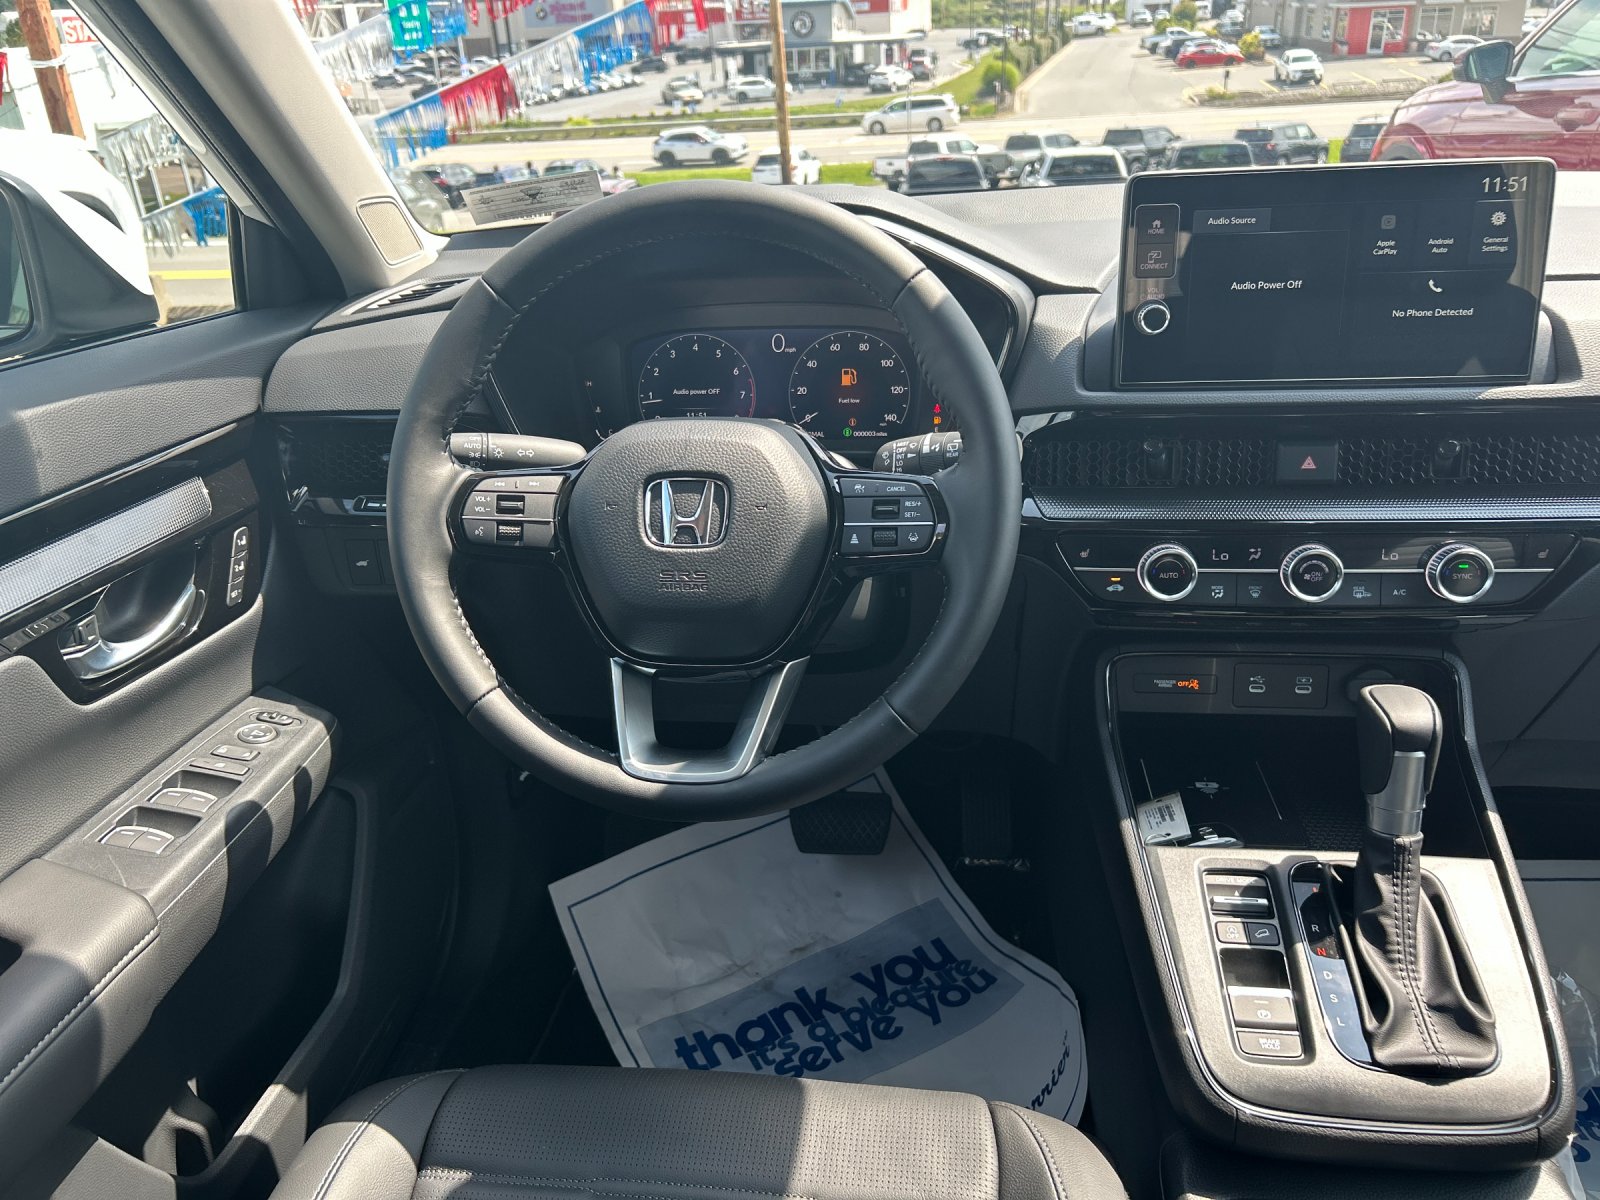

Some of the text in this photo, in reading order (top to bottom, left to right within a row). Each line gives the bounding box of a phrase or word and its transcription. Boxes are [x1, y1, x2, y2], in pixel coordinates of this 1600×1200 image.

[1481, 176, 1529, 193] 11:51
[1207, 216, 1257, 226] Audio Source
[1376, 239, 1396, 247] Apple
[1427, 238, 1454, 246] Android
[1483, 236, 1509, 244] General
[1372, 248, 1398, 256] CarPlay
[1481, 245, 1509, 253] Settings
[1140, 262, 1168, 270] CONNECT
[1230, 280, 1303, 290] Audio Power Off
[1392, 307, 1474, 318] No Phone Detected
[692, 343, 699, 352] 4
[771, 333, 786, 353] 0
[829, 343, 841, 352] 60
[858, 342, 870, 351] 80
[670, 350, 676, 359] 3
[715, 349, 722, 358] 5
[806, 360, 818, 368] 40
[880, 359, 894, 368] 100
[653, 367, 660, 376] 2
[733, 367, 739, 376] 6
[796, 386, 808, 395] 20
[890, 386, 904, 394] 120
[648, 391, 653, 400] 1
[740, 391, 746, 400] 7
[884, 413, 897, 422] 140
[1212, 548, 1229, 561] Lo
[1381, 548, 1399, 561] Lo
[659, 571, 707, 582] SRS
[658, 583, 709, 592] AIRBAG
[1392, 588, 1407, 596] A/C
[1177, 680, 1190, 688] OFF
[1311, 924, 1320, 933] R
[1316, 947, 1327, 957] N
[1323, 970, 1333, 980] D
[1329, 993, 1339, 1003] S
[674, 937, 960, 1071] thank you
[747, 958, 979, 1071] it's a pleasure
[774, 967, 998, 1078] serve you
[1336, 1017, 1346, 1027] L
